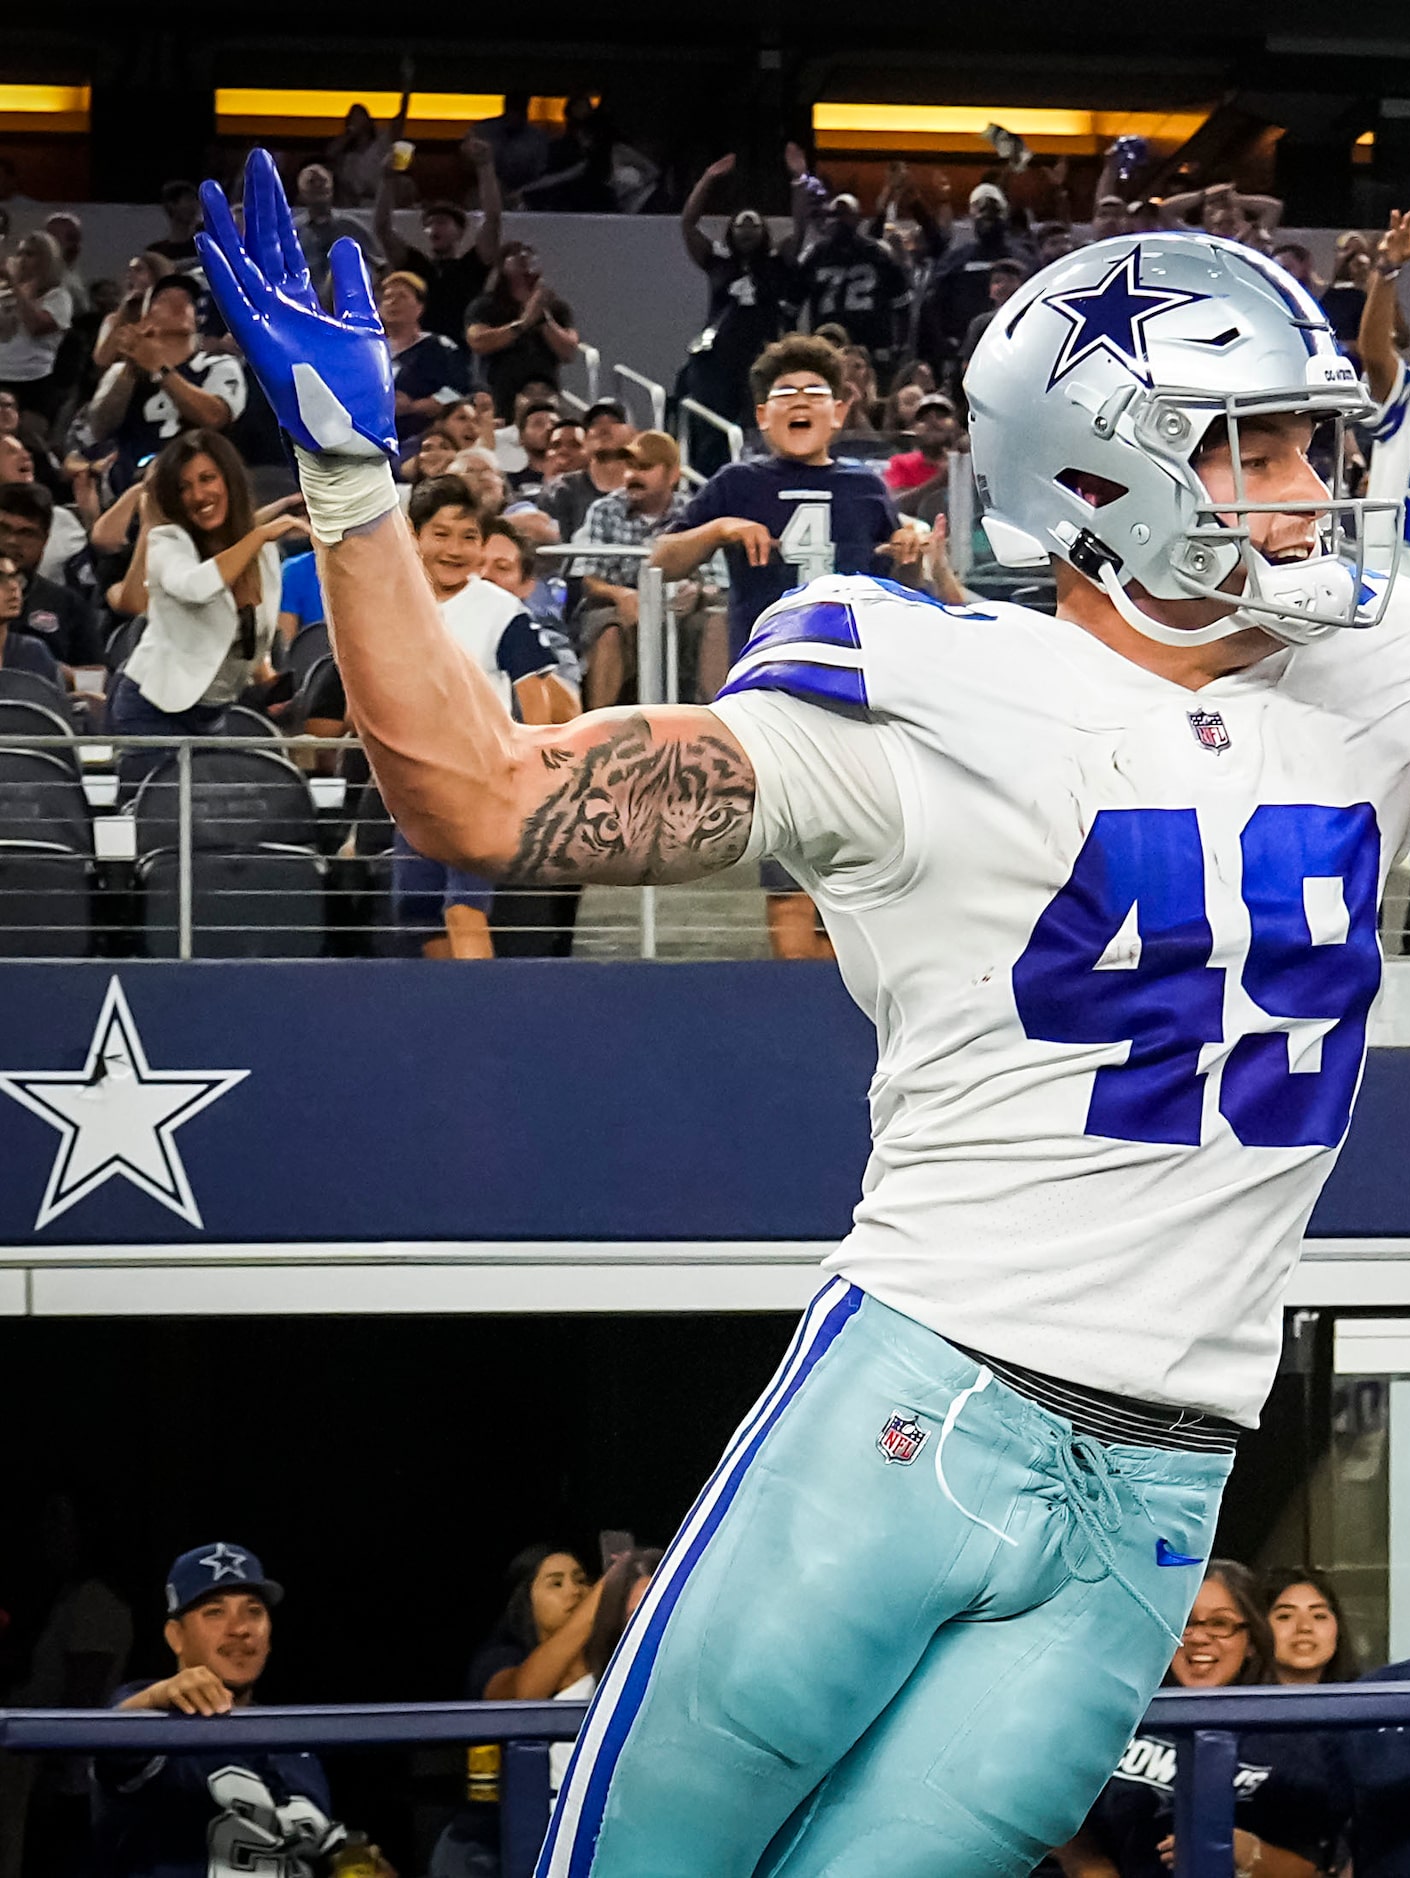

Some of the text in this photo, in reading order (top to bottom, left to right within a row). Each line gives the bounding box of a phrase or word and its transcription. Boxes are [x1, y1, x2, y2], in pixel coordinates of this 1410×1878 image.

[815, 263, 877, 314] 72
[778, 502, 837, 588] 4
[1012, 801, 1385, 1147] 49
[883, 1430, 914, 1459] NFL
